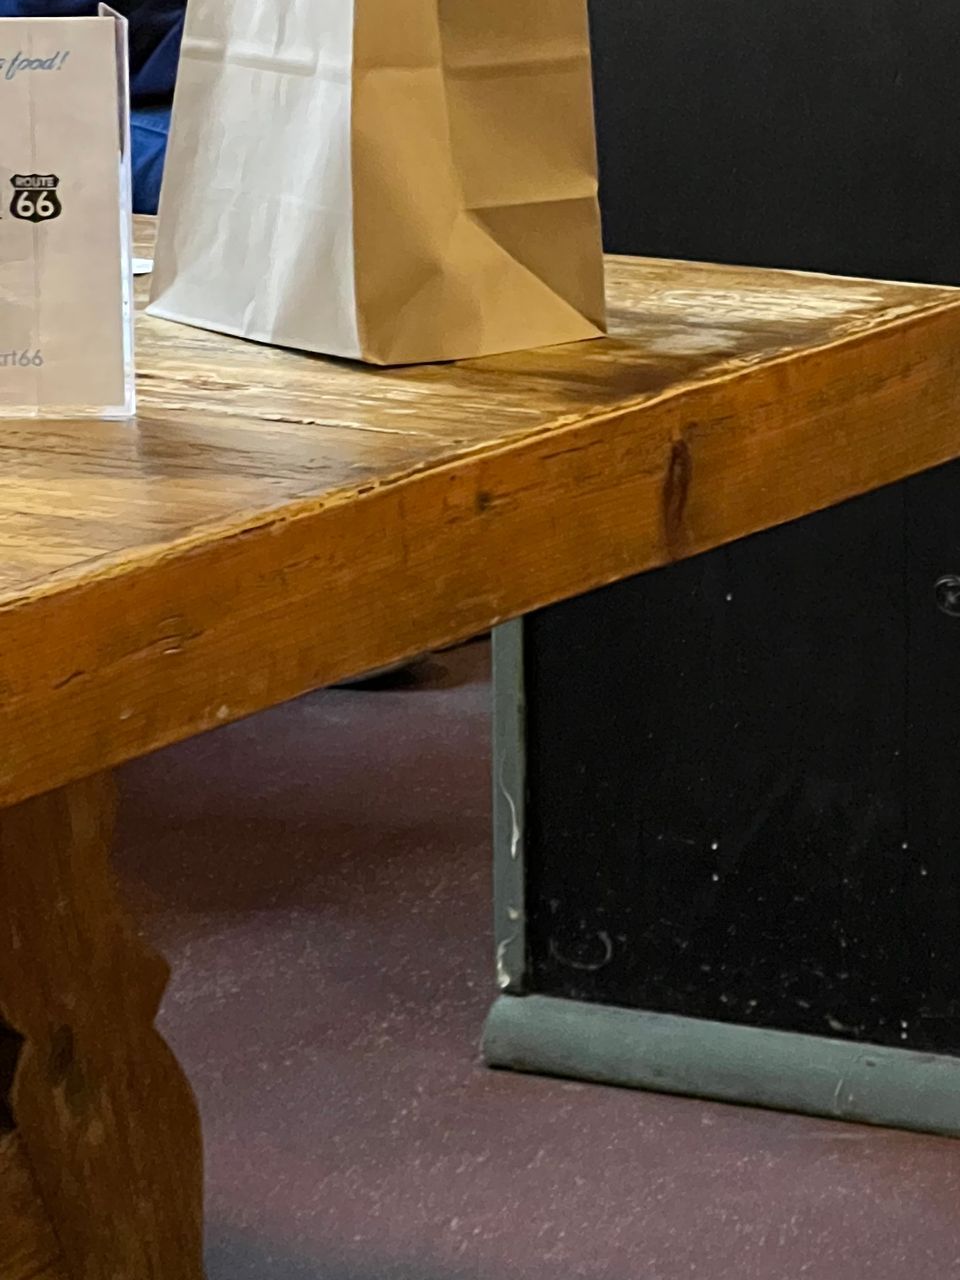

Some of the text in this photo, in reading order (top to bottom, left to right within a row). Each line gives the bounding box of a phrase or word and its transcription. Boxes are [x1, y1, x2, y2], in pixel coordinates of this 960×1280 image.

[5, 51, 70, 80] food!
[15, 176, 55, 187] ROUTE
[17, 191, 54, 217] 66
